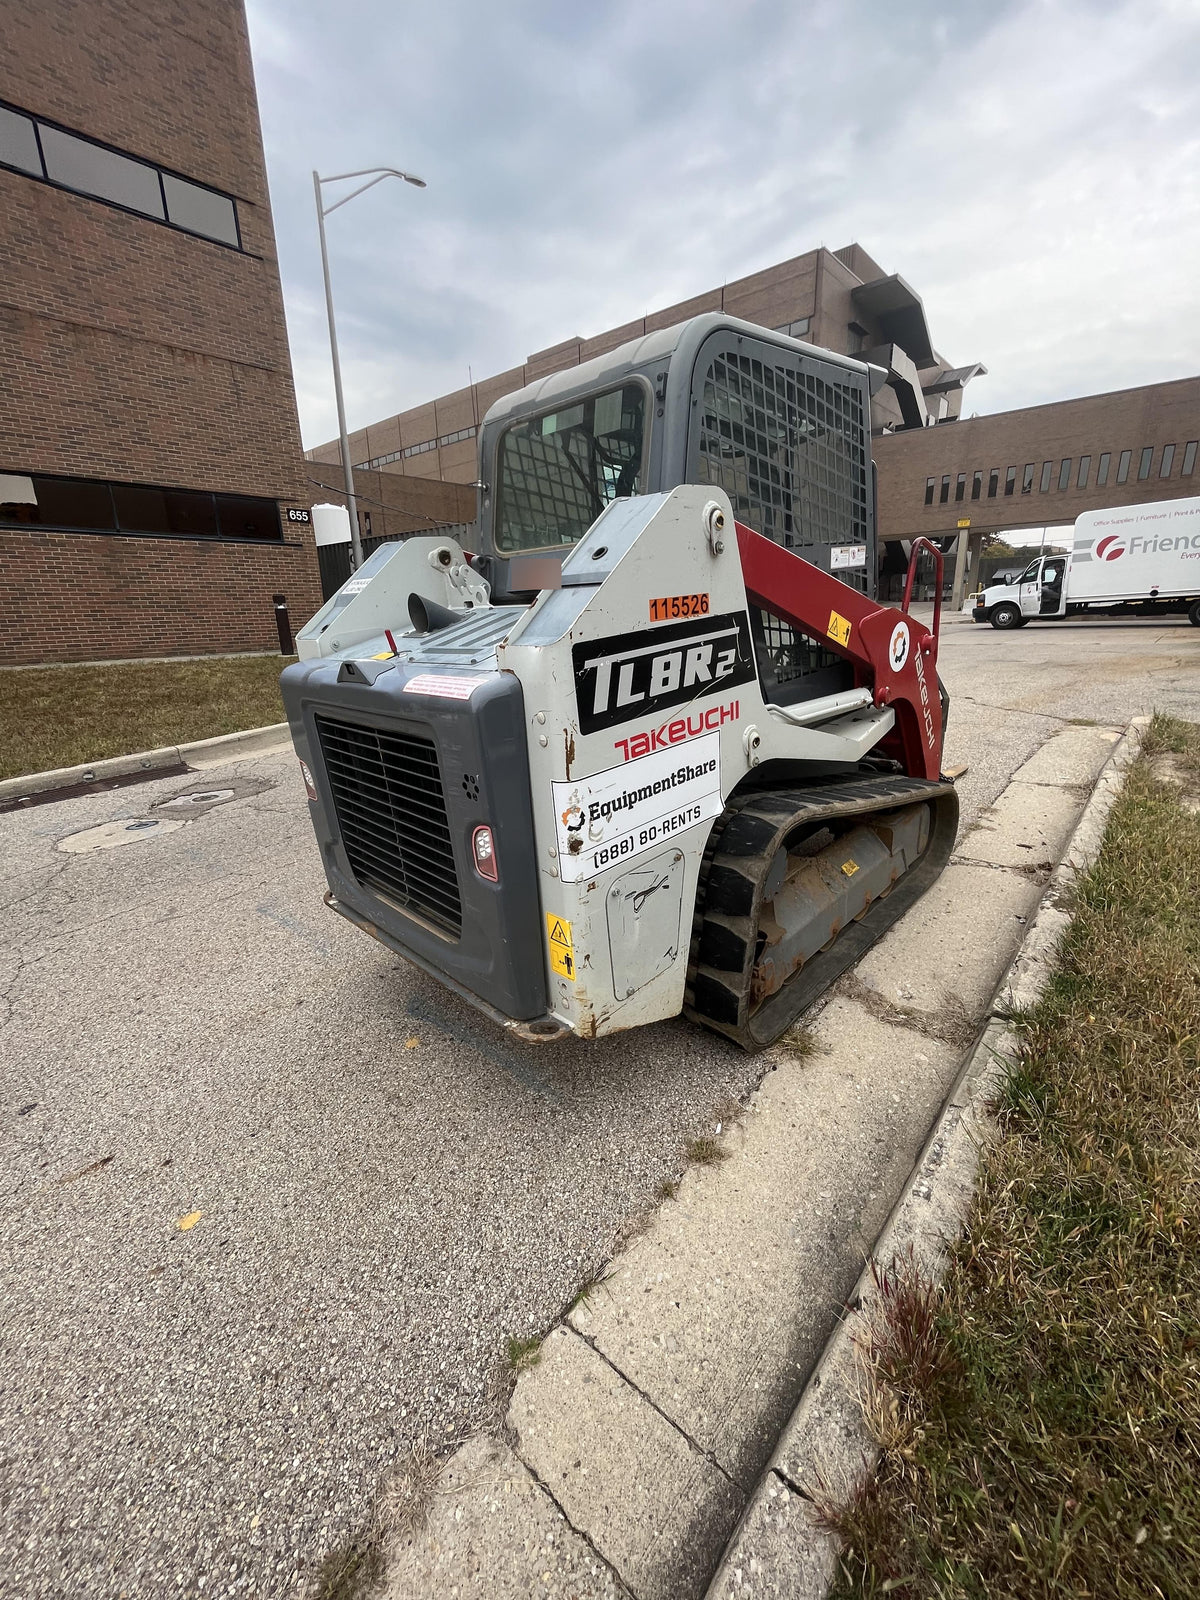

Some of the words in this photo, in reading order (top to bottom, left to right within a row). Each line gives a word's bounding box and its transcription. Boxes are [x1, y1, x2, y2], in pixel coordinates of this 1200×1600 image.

[289, 510, 309, 522] 655
[1110, 517, 1134, 525] Supplies
[1140, 513, 1167, 521] Furniture
[651, 594, 709, 619] 115526
[584, 627, 740, 715] TL8R2
[588, 759, 717, 821] EquipmentShare
[593, 835, 635, 869] (888)
[639, 805, 702, 846] 80-RENTS
